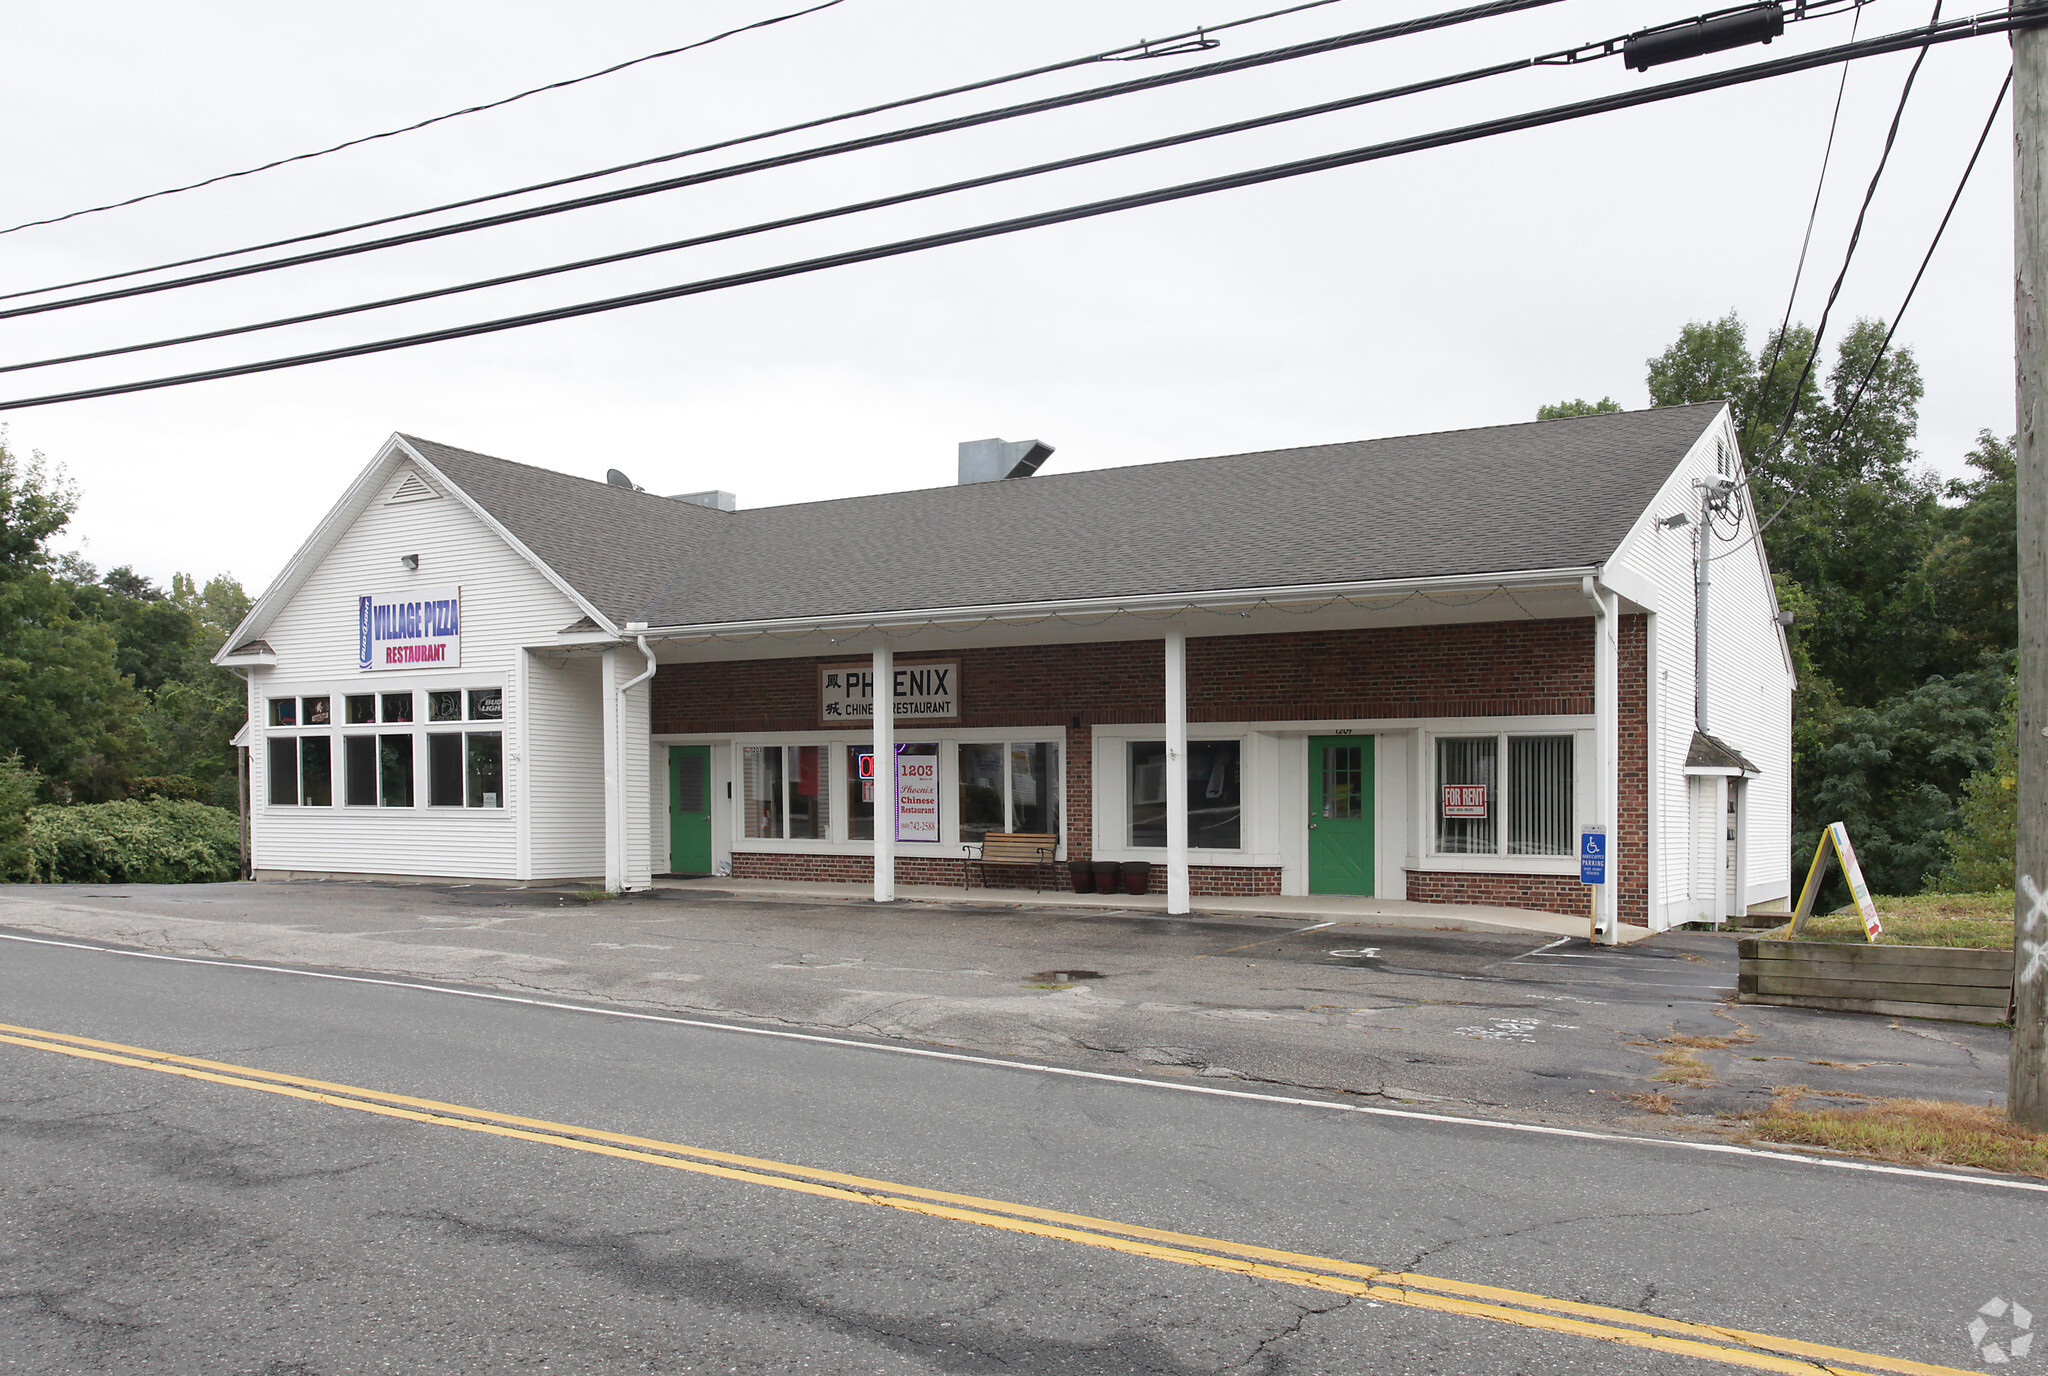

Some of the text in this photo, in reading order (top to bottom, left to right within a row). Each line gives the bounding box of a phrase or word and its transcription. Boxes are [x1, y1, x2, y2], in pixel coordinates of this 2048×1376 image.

[374, 599, 458, 641] VILLAGE PIZZA
[360, 598, 370, 660] BUD LIGHT
[386, 643, 446, 664] RESTAURANT
[846, 669, 949, 698] PHENIX
[846, 701, 951, 715] CHINE RESTAURANT
[901, 765, 933, 776] 1203
[900, 784, 934, 794] Phoenix
[1445, 787, 1483, 805] FOR RENT
[900, 796, 935, 804] Chinese
[900, 806, 935, 814] Restaurant
